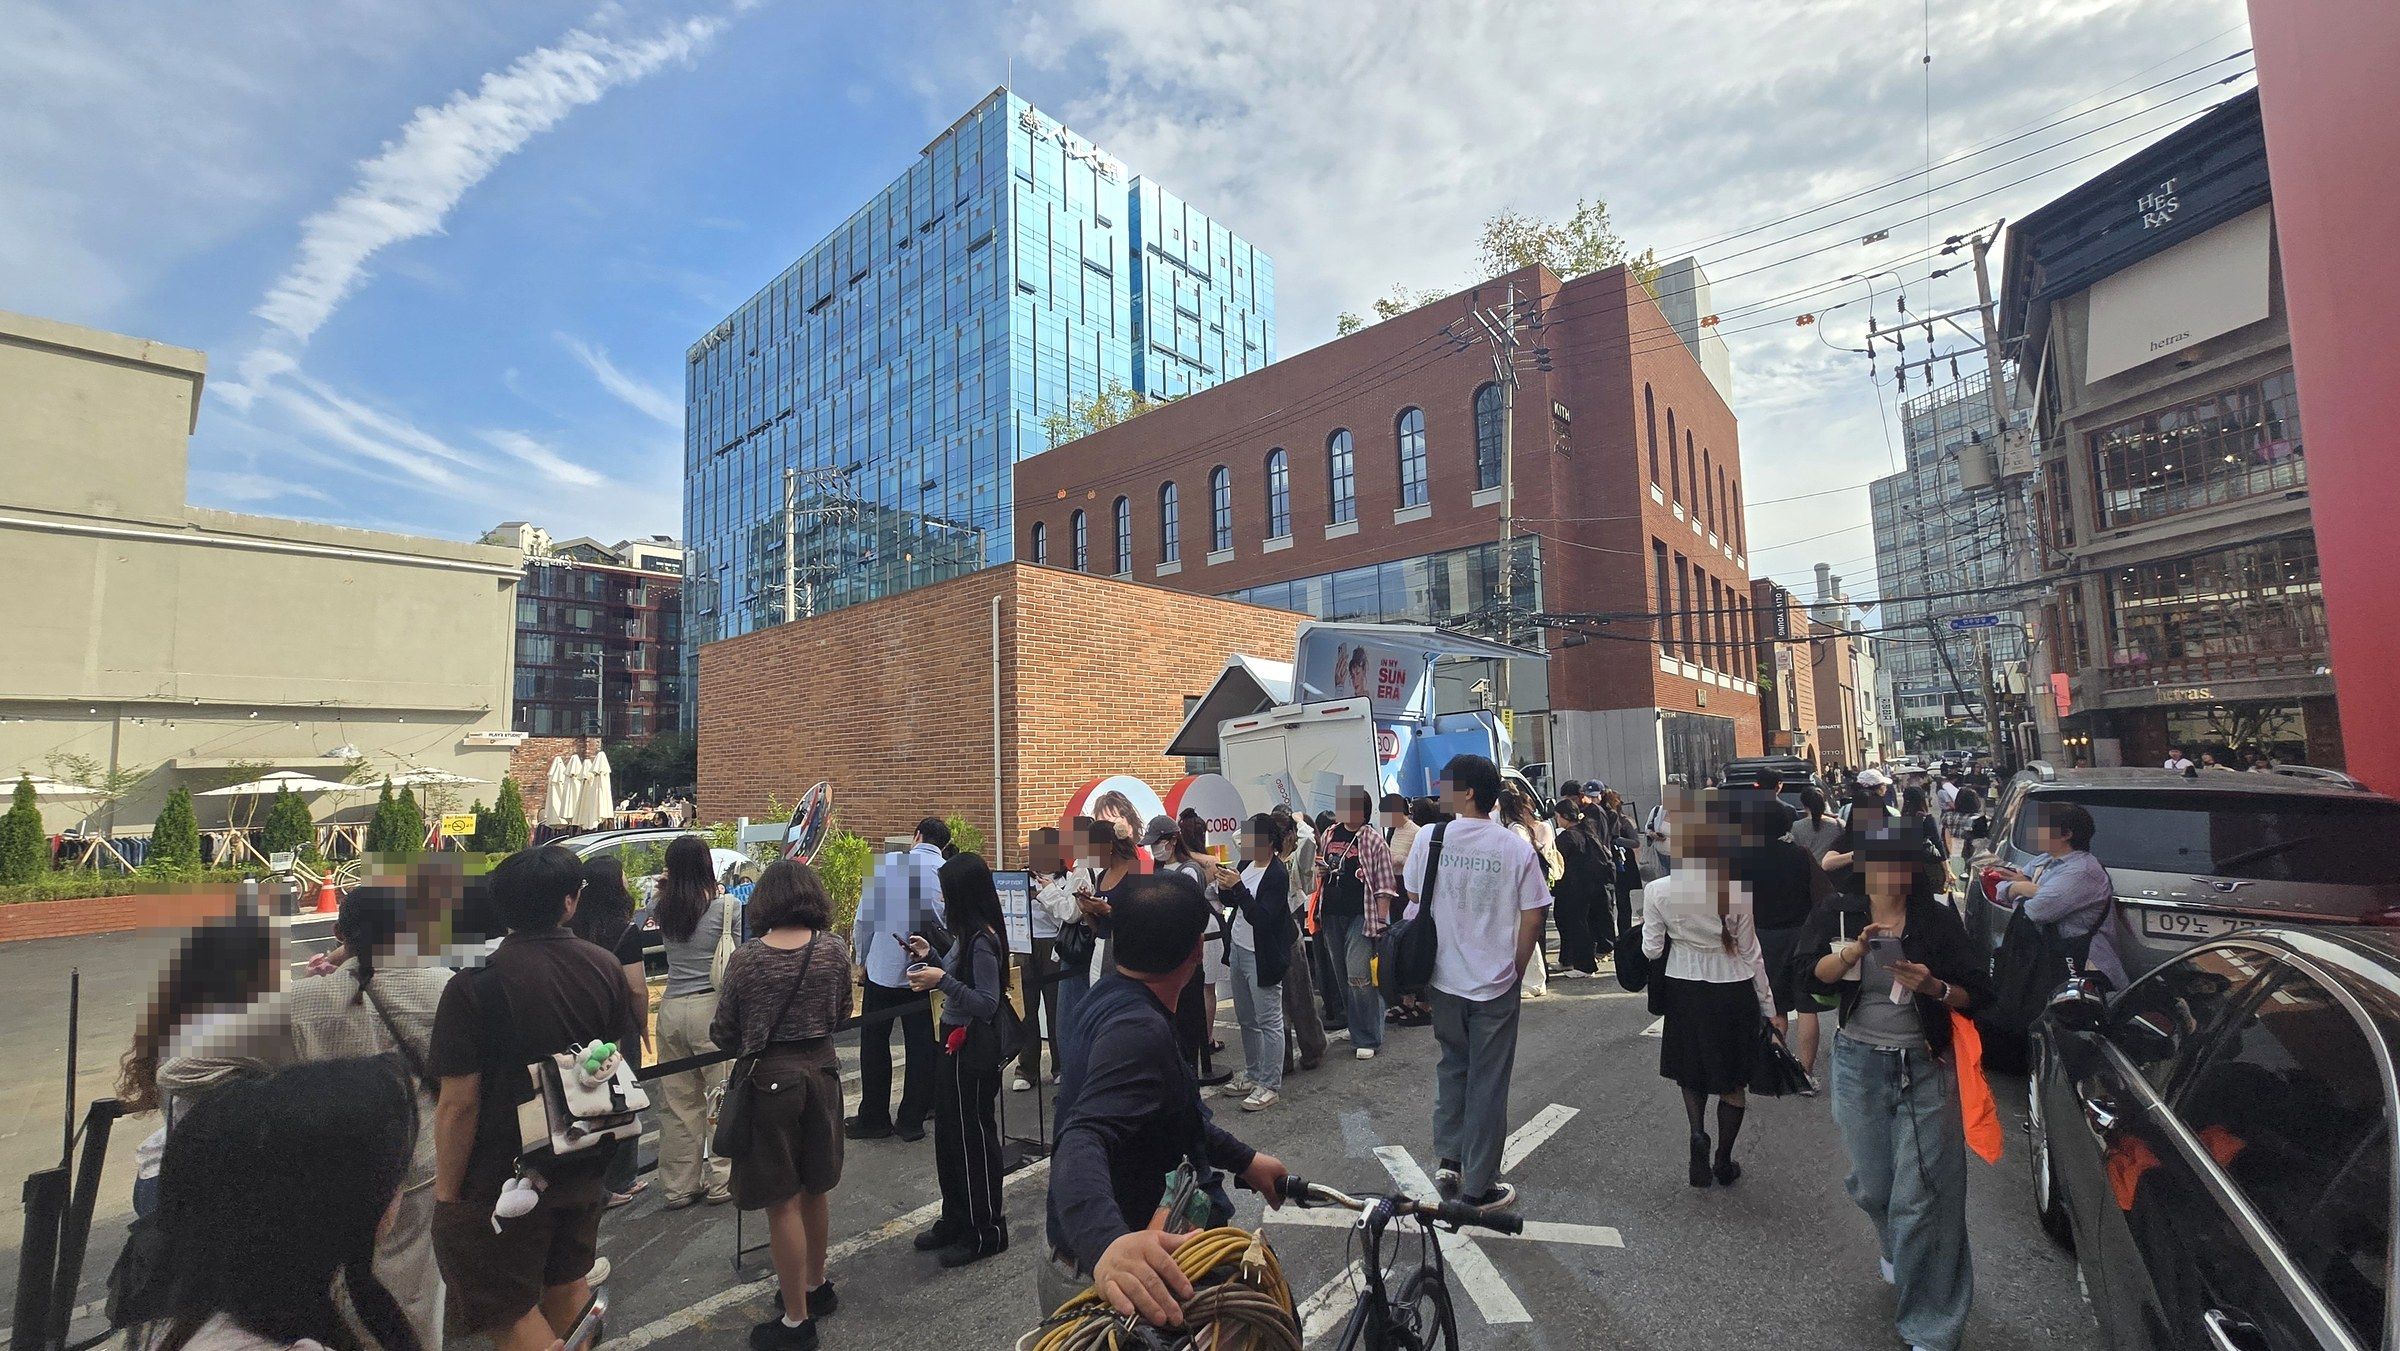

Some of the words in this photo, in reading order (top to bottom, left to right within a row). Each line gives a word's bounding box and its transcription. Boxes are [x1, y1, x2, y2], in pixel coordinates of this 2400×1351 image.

[1554, 401, 1571, 422] KITH
[1777, 613, 1786, 636] YOUNG
[1378, 667, 1407, 686] SUN
[1377, 685, 1401, 700] ERA
[2159, 913, 2210, 934] 09노
